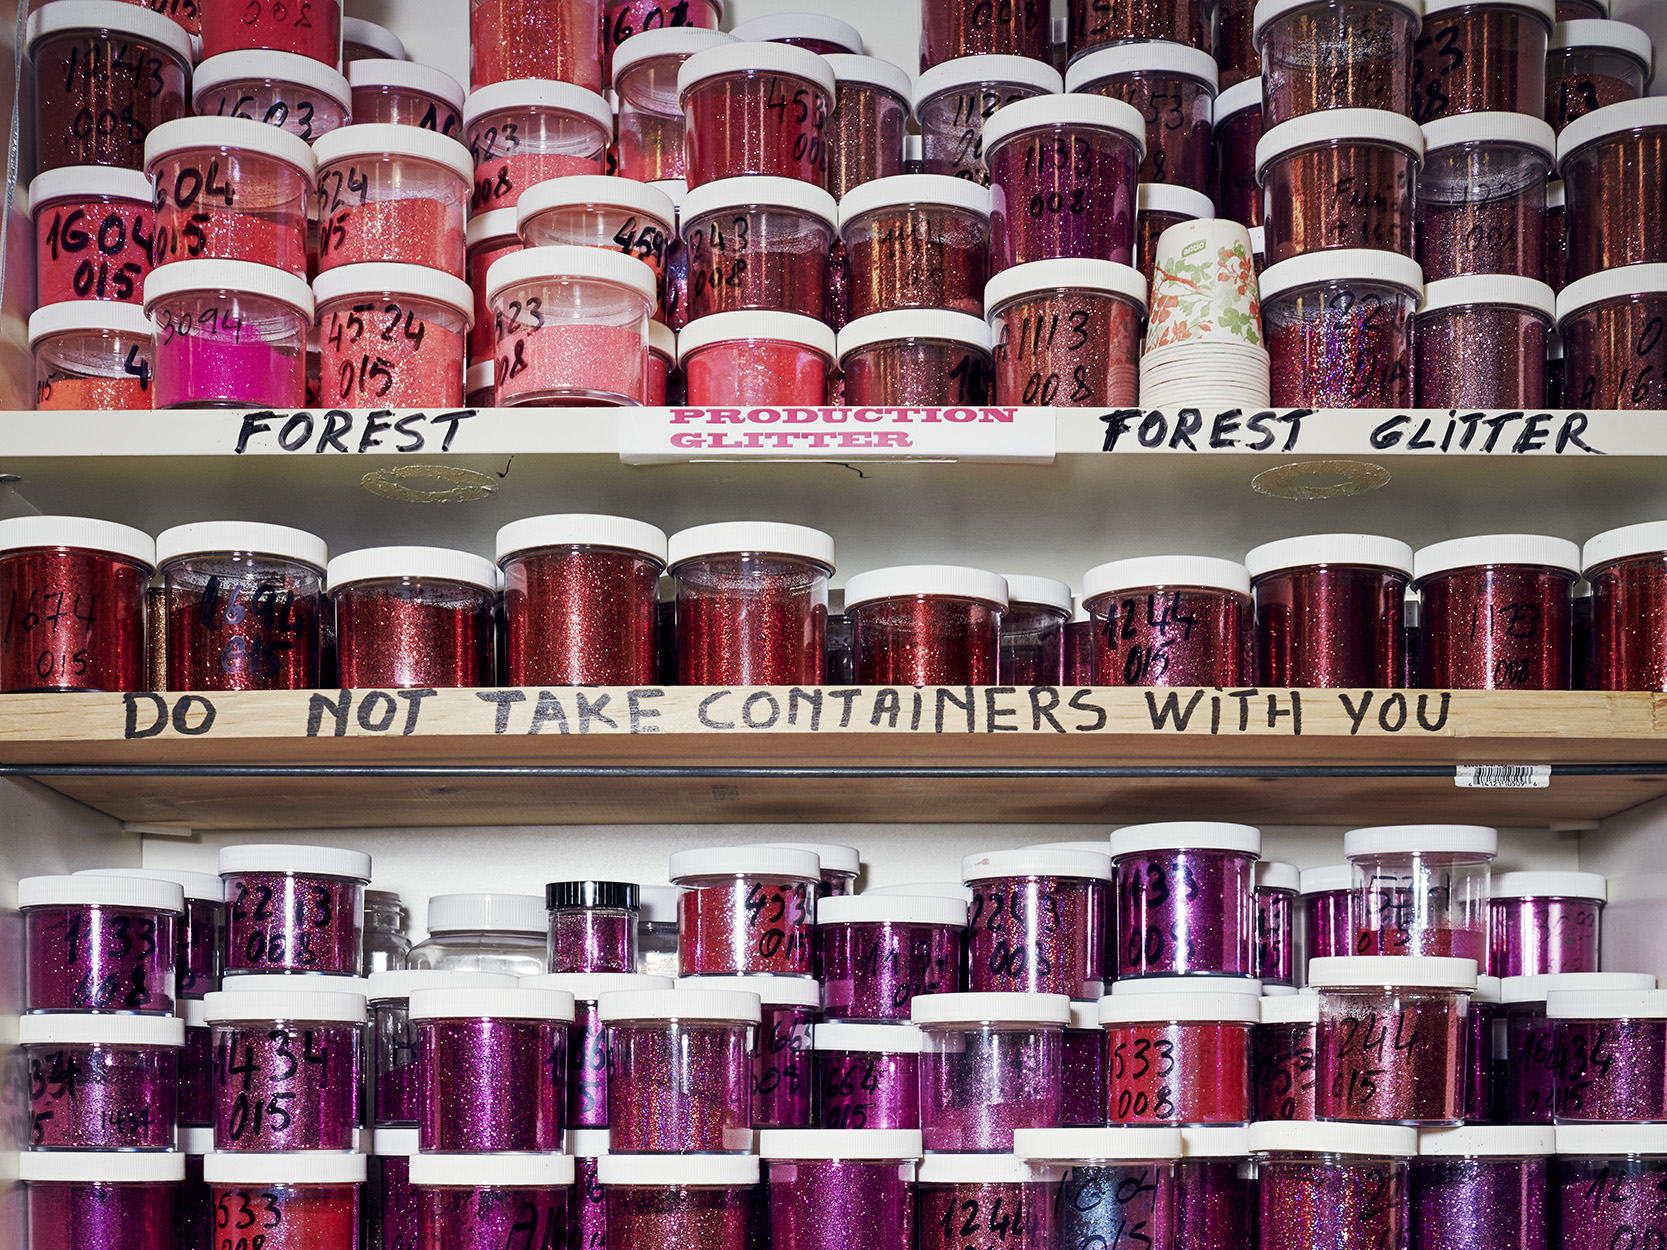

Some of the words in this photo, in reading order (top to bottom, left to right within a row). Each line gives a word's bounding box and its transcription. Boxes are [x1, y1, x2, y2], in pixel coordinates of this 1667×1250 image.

[953, 92, 1026, 127] 112
[73, 259, 142, 300] 015
[328, 302, 425, 352] 4524
[339, 356, 396, 399] 015
[1022, 364, 1093, 407] 008
[234, 409, 482, 455] FOREST
[669, 407, 1019, 425] PRODUCTION
[1098, 407, 1321, 453] FOREST
[669, 430, 914, 449] GLITTER
[1101, 589, 1201, 651] 1244
[36, 649, 90, 681] 015
[122, 690, 218, 740] DO
[306, 688, 439, 738] NOT
[476, 687, 666, 736] TAKE
[1338, 691, 1453, 737] YOU
[228, 1091, 297, 1143] 015
[1117, 1087, 1176, 1120] 008
